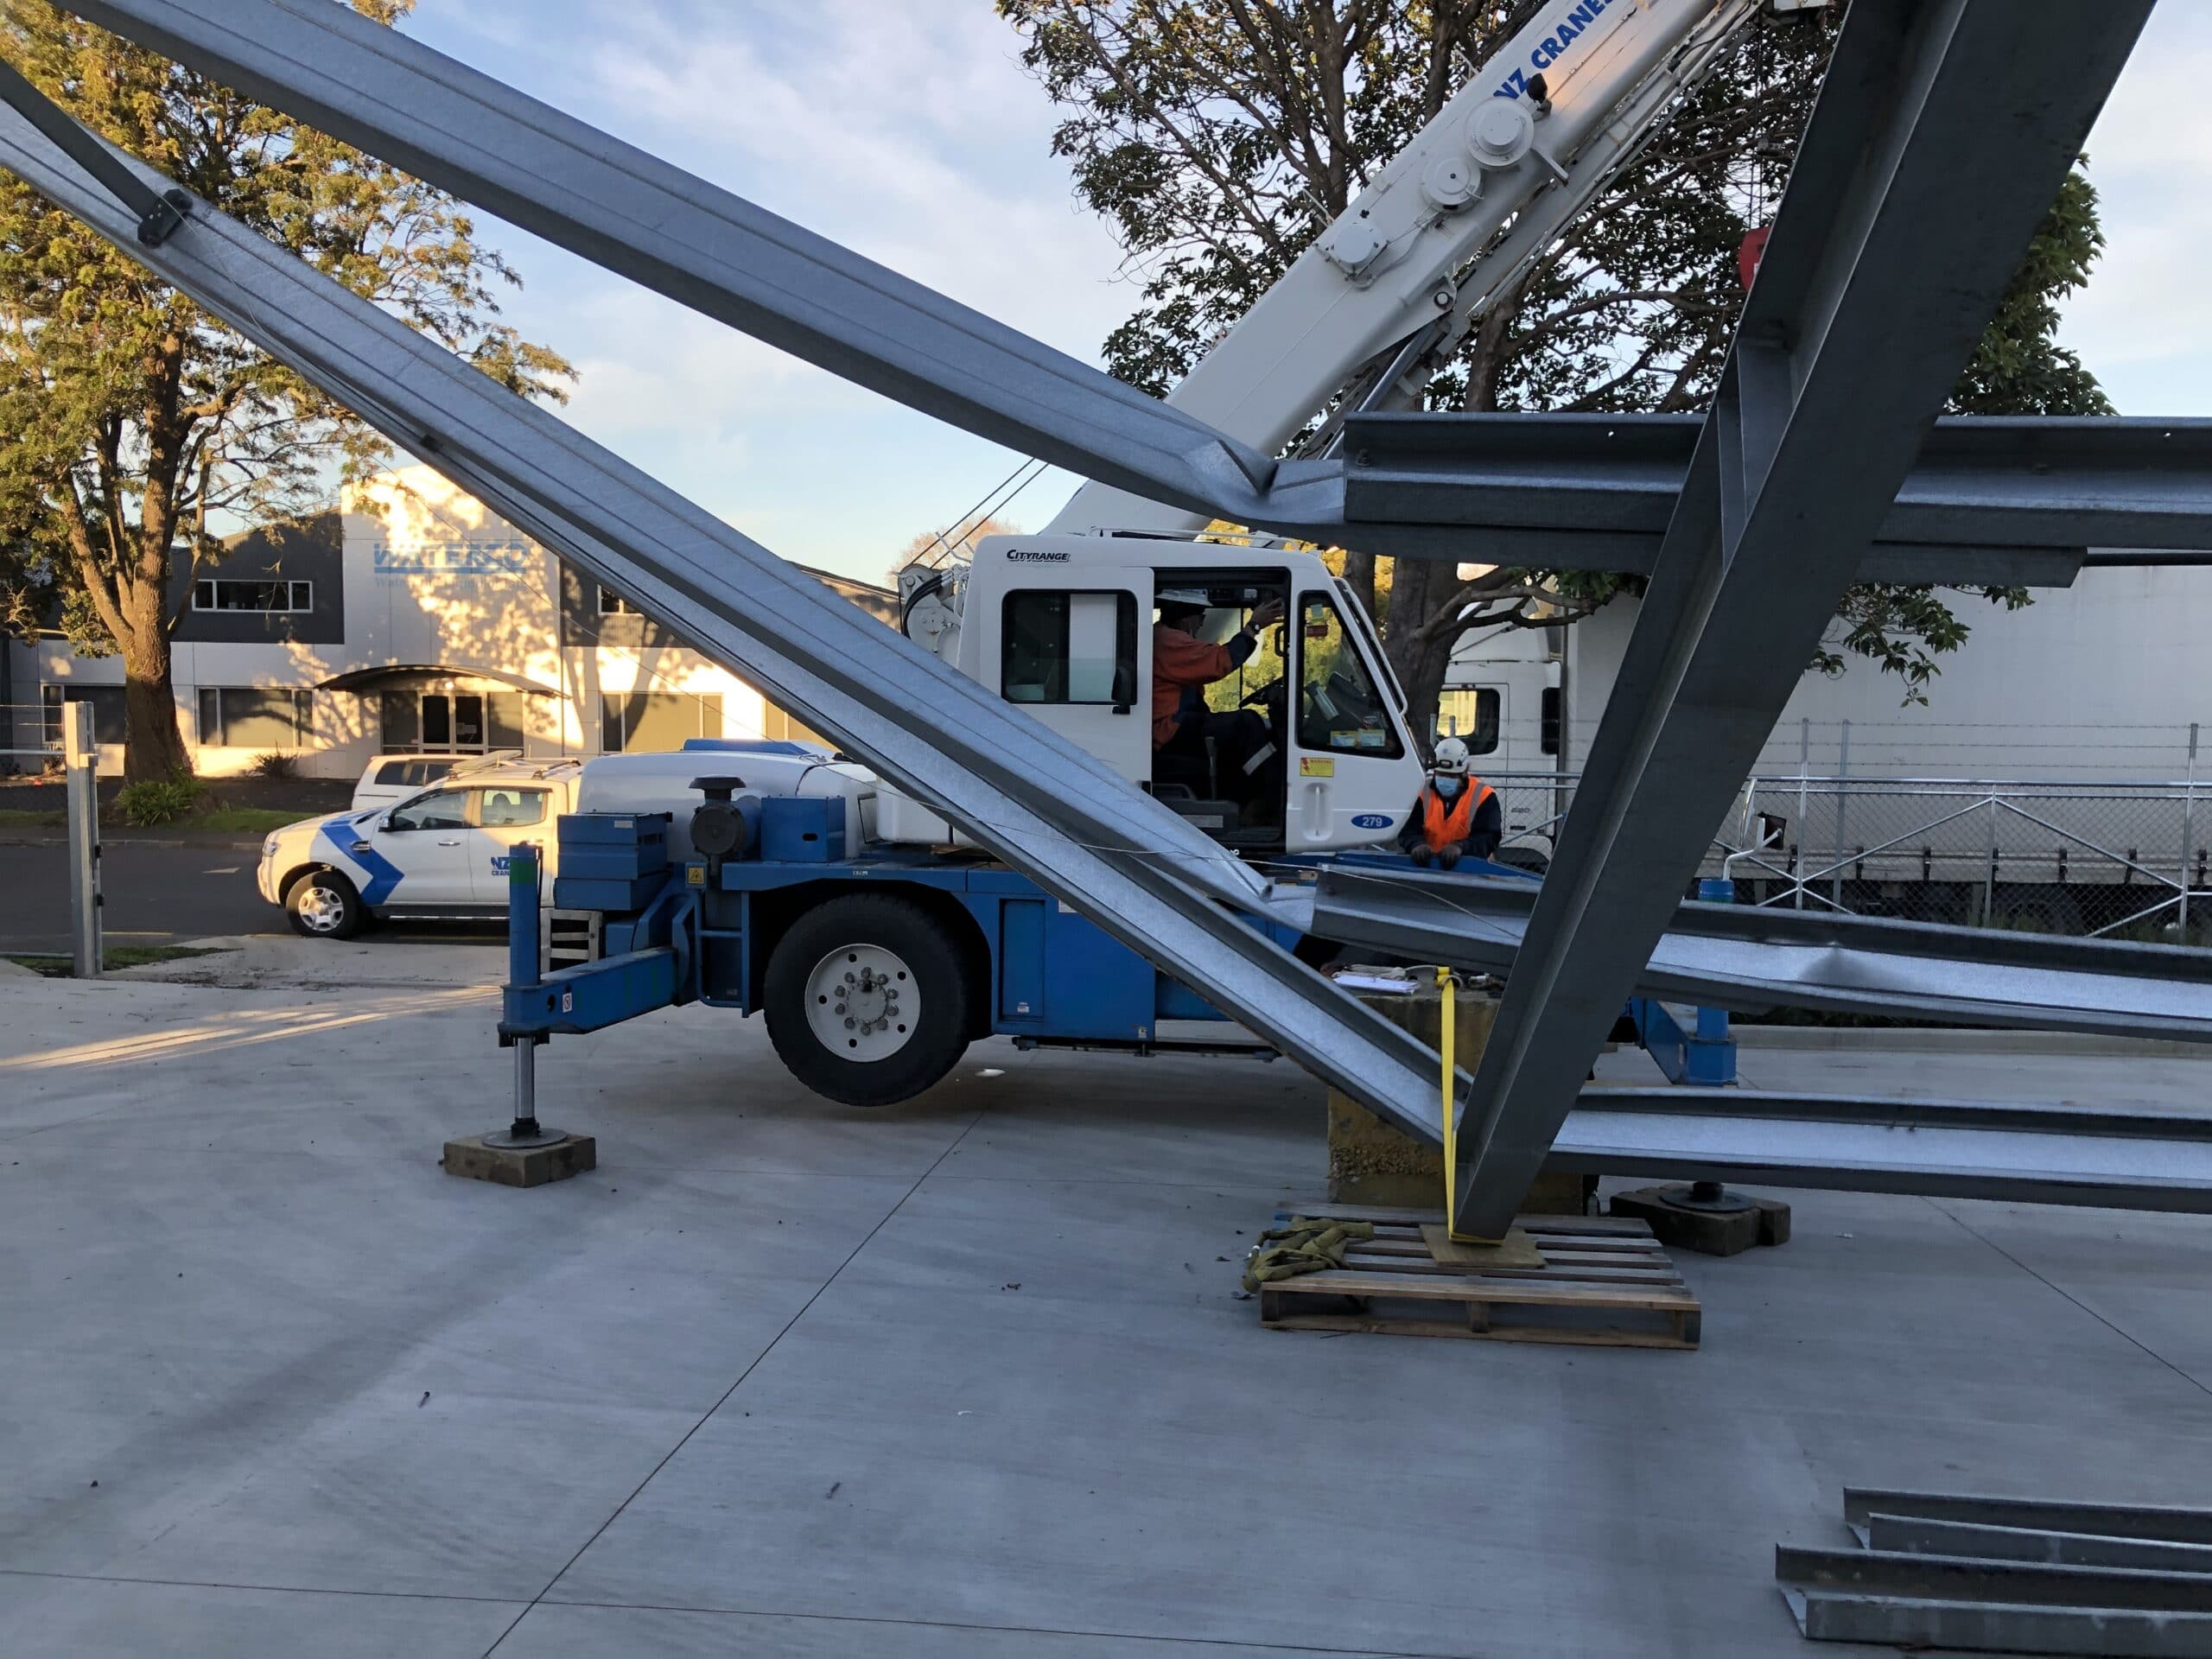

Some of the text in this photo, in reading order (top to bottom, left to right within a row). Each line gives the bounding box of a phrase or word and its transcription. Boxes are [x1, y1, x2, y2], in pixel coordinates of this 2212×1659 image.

[1493, 0, 1612, 100] NZ CRANE
[1007, 549, 1070, 563] CITYRANGE
[1363, 817, 1382, 827] 279
[491, 857, 510, 869] NZ
